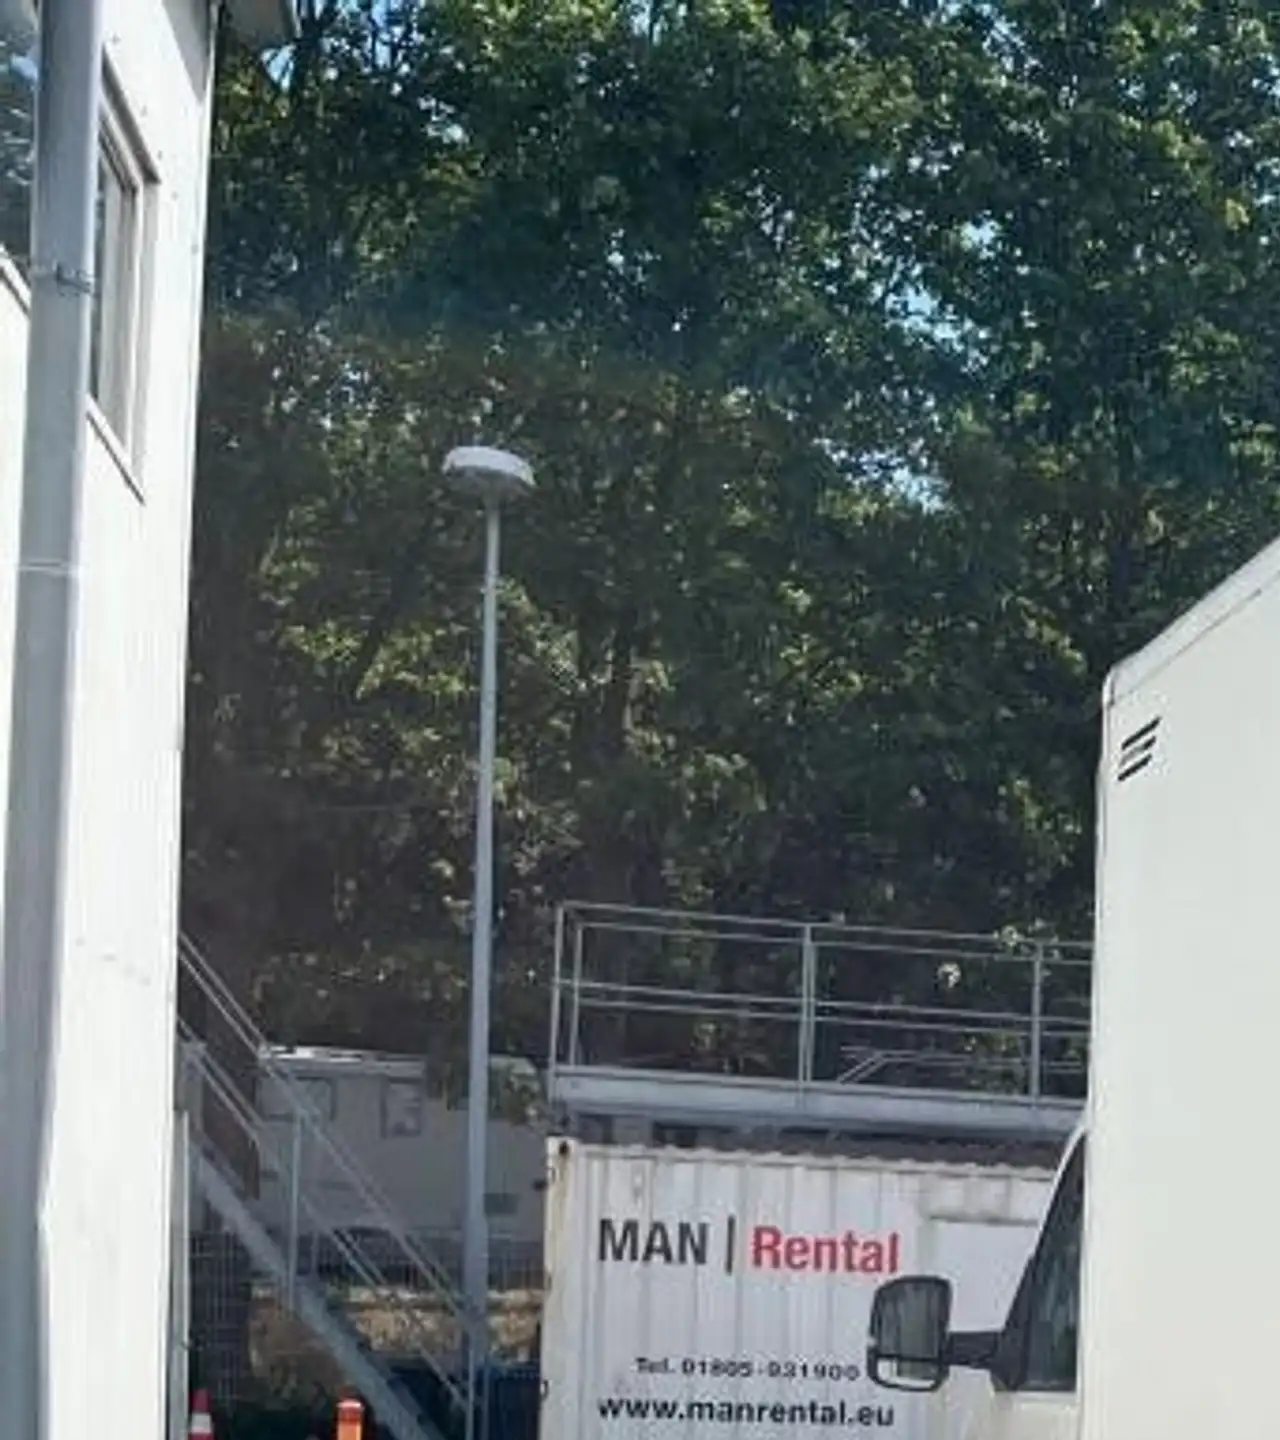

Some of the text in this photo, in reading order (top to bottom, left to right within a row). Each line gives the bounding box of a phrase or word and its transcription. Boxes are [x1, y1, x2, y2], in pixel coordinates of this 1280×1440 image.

[599, 1217, 899, 1274] MAN Rental
[598, 1398, 895, 1427] www.manrental.eu
